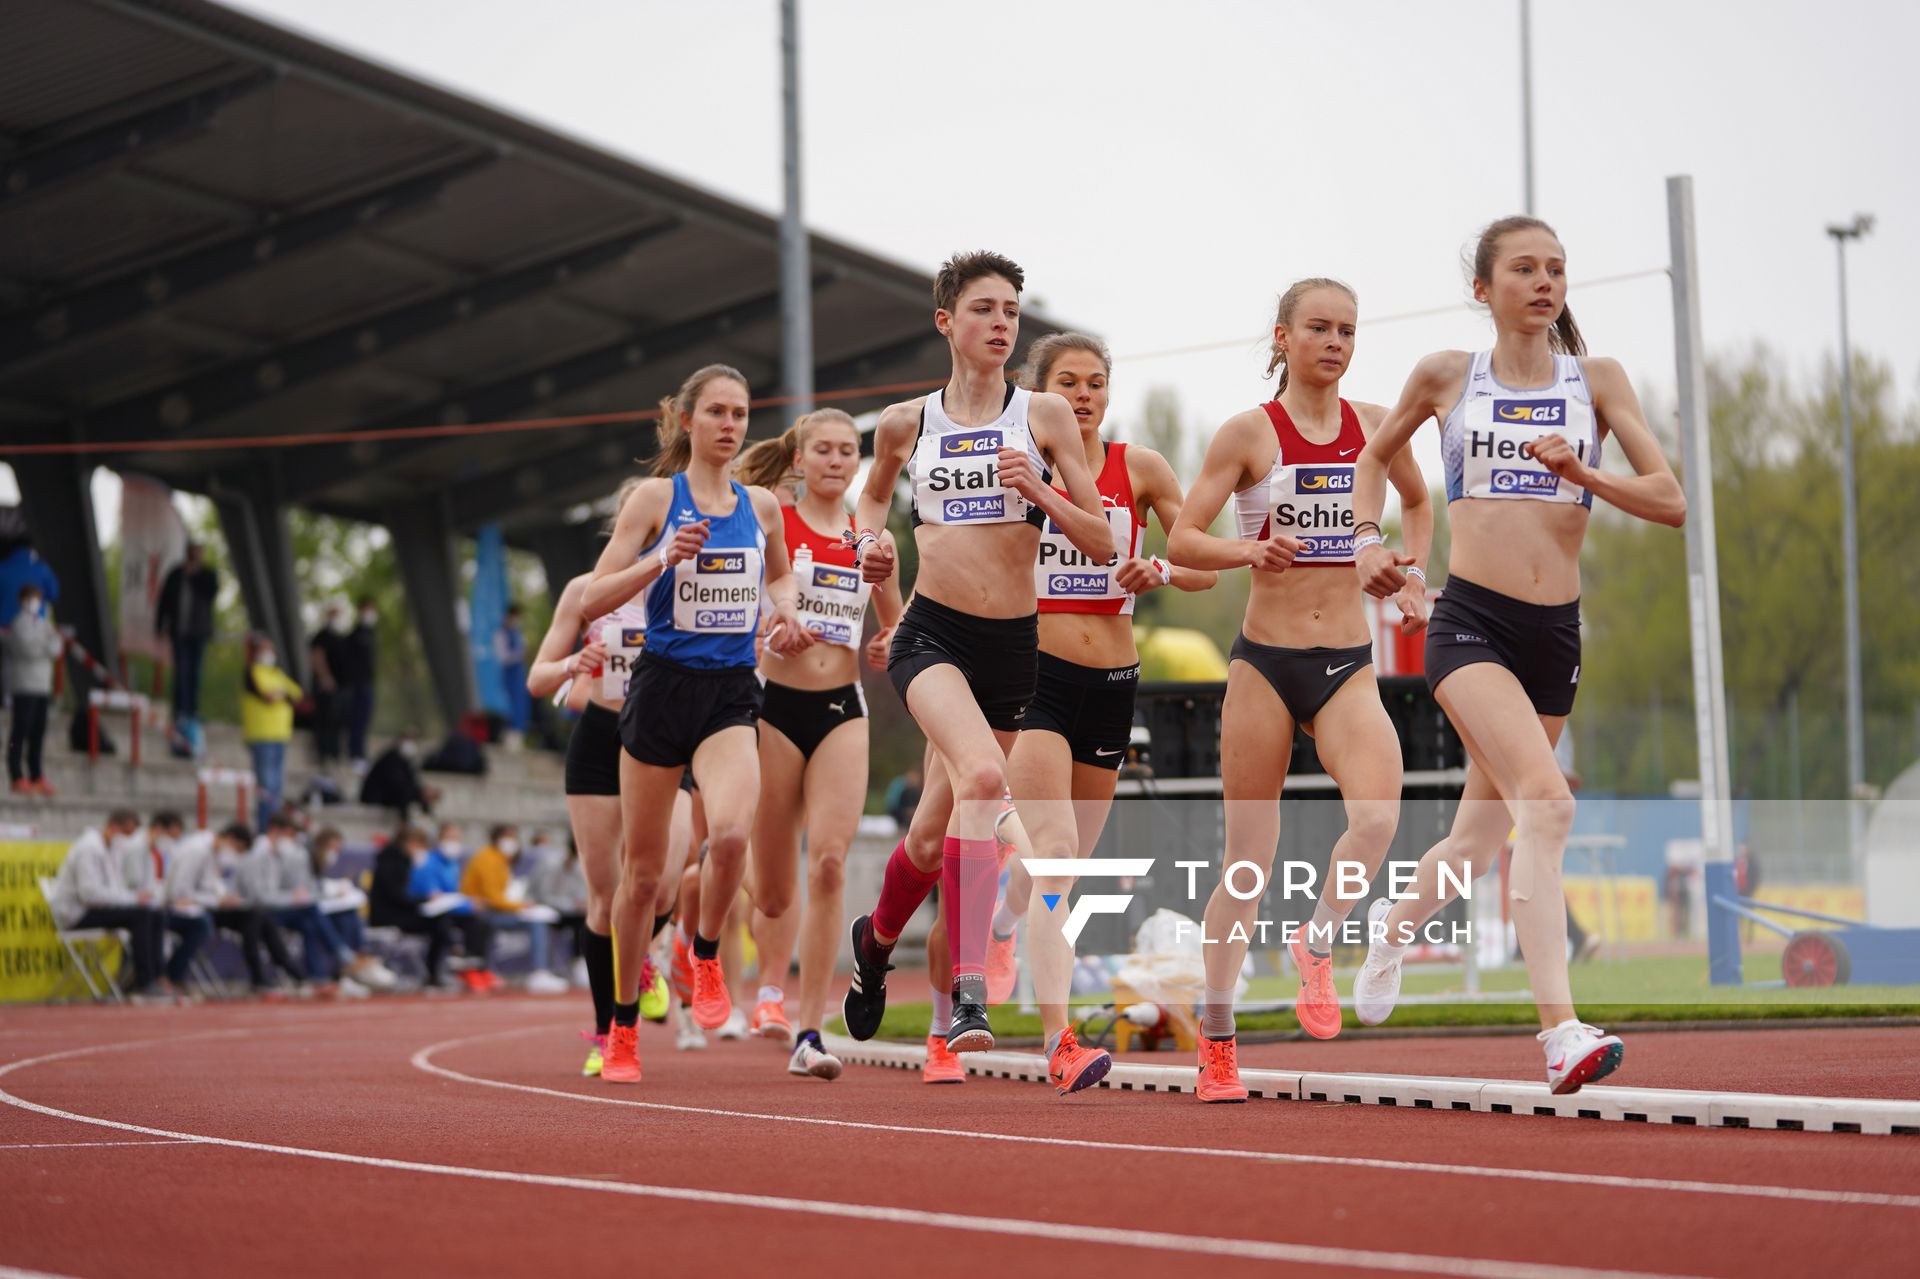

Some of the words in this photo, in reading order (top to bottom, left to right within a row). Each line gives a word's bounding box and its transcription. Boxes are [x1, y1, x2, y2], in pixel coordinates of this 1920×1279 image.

[1531, 406, 1560, 421] GLS
[973, 437, 998, 452] GLS
[1471, 430, 1585, 462] Hecl
[928, 463, 1004, 492] Stah
[1328, 474, 1352, 489] GLS
[1519, 474, 1558, 487] PLAN
[968, 499, 1003, 511] PLAN
[1320, 539, 1354, 549] PLAN
[724, 558, 743, 570] GLS
[838, 574, 857, 588] GLS
[1072, 577, 1106, 587] PLAN
[679, 581, 758, 602] Clemens
[717, 611, 745, 621] PLAN
[826, 625, 851, 637] PLAN
[1107, 668, 1134, 681] NIKE
